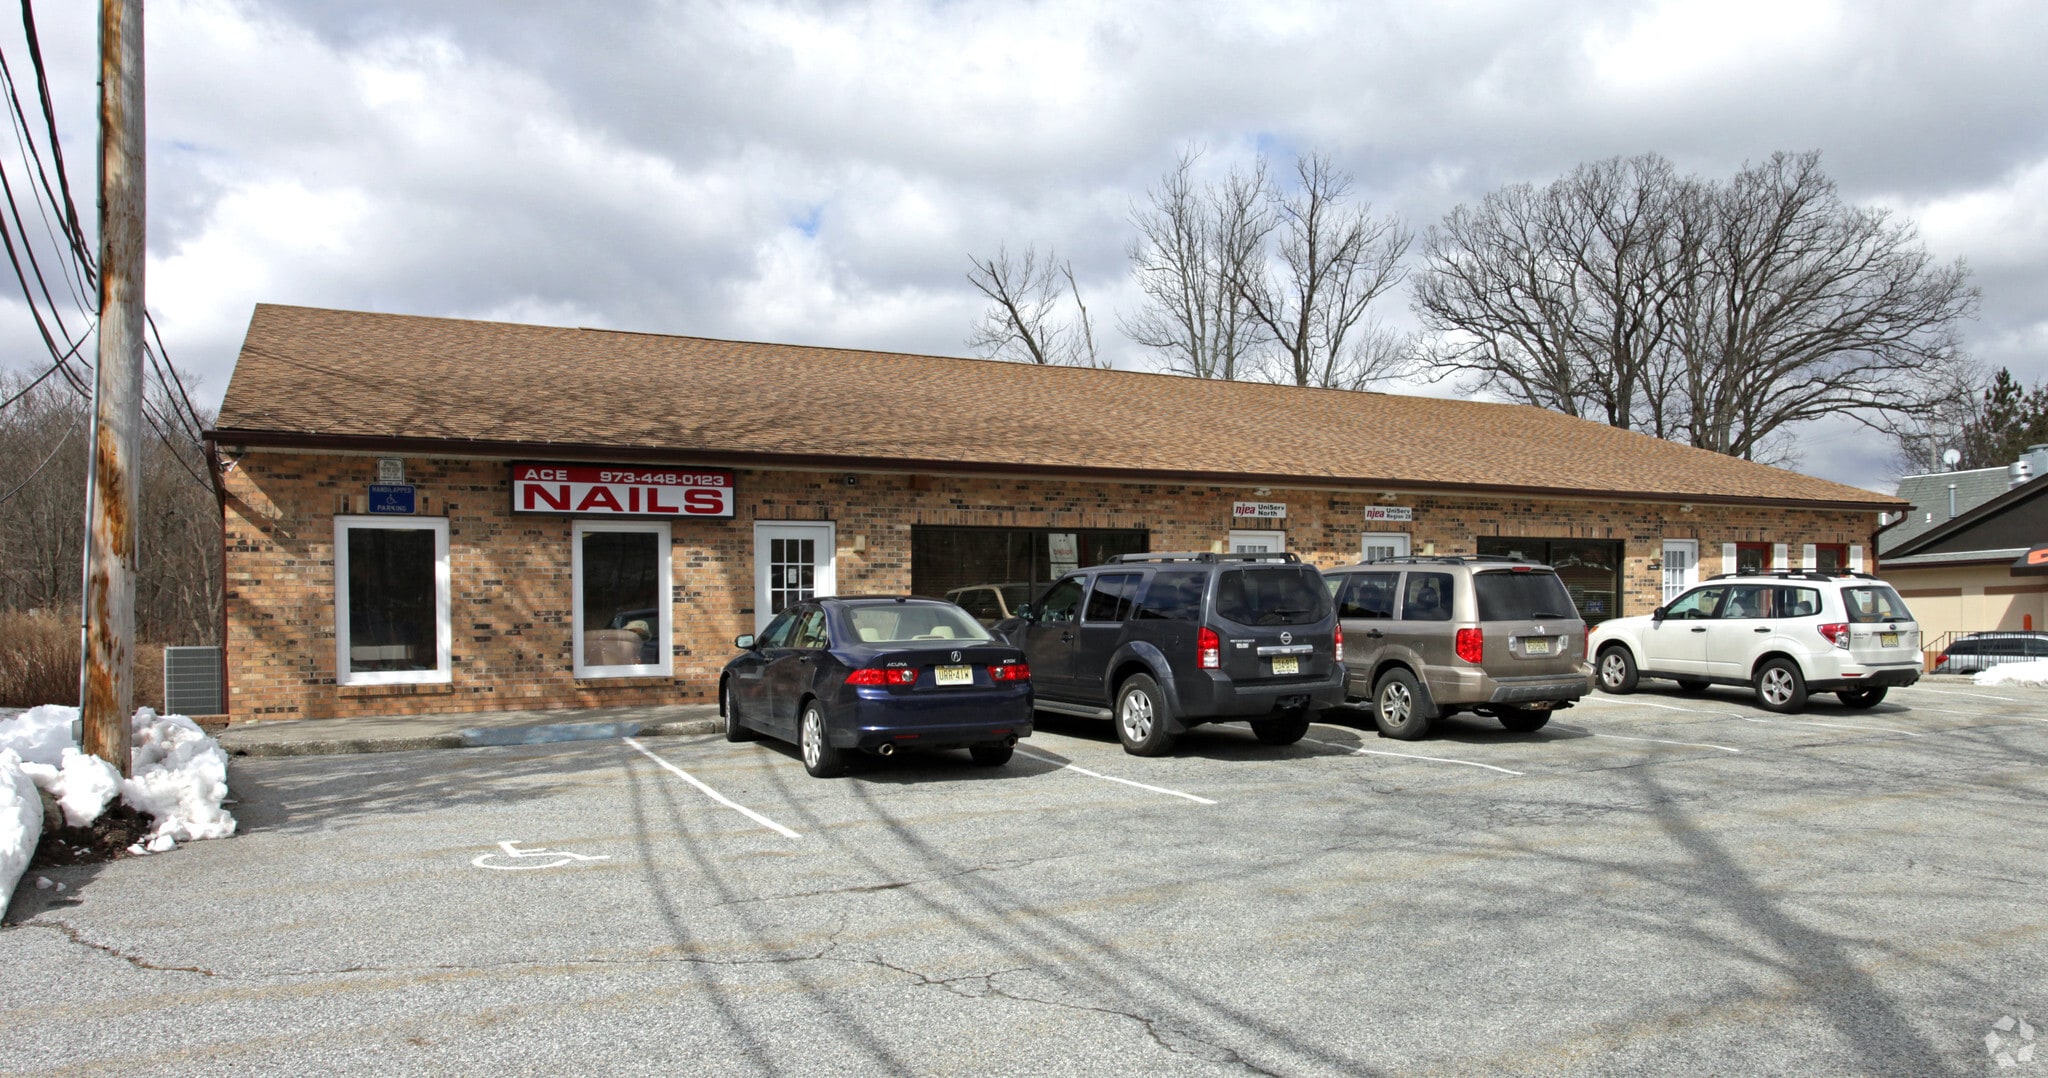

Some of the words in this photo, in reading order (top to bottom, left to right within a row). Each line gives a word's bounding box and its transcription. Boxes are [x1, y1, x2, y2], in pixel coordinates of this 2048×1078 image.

[524, 468, 568, 481] ACE
[599, 471, 725, 487] 973-448-0123
[523, 483, 725, 515] NAILS
[377, 504, 407, 512] PARKING
[1235, 503, 1256, 516] njea
[1257, 503, 1285, 511] UniServ
[1366, 507, 1385, 519] njea
